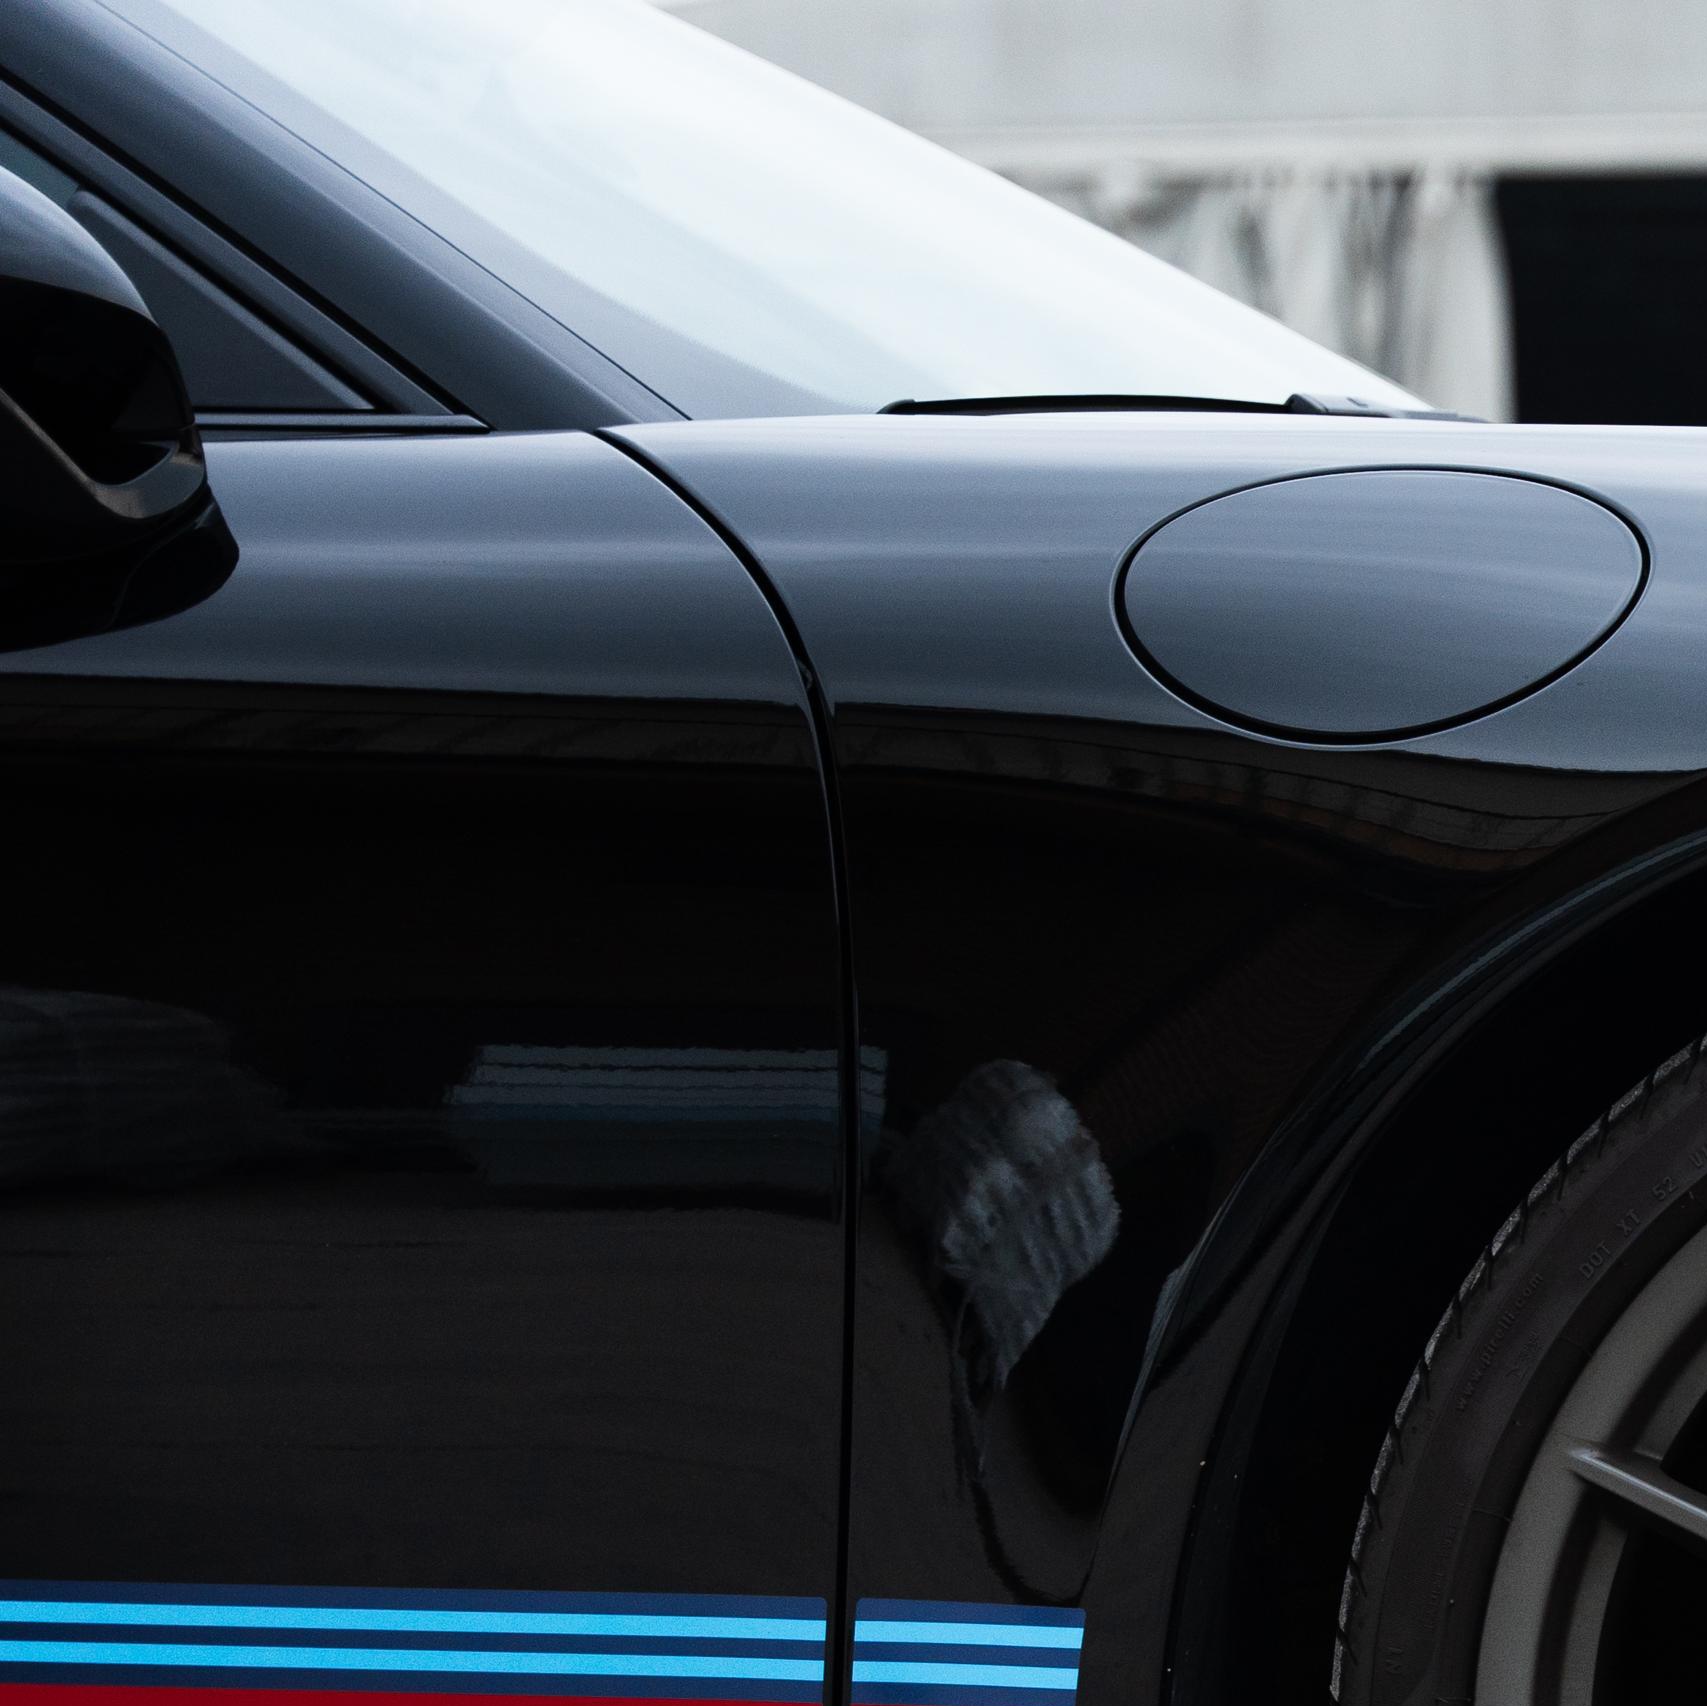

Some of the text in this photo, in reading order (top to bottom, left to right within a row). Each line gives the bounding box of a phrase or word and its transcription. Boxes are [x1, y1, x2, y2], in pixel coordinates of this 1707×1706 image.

[1578, 1240, 1613, 1280] DOT
[1615, 1208, 1641, 1238] XT
[1651, 1175, 1679, 1202] 52
[1455, 1272, 1546, 1413] www.pirelli.com
